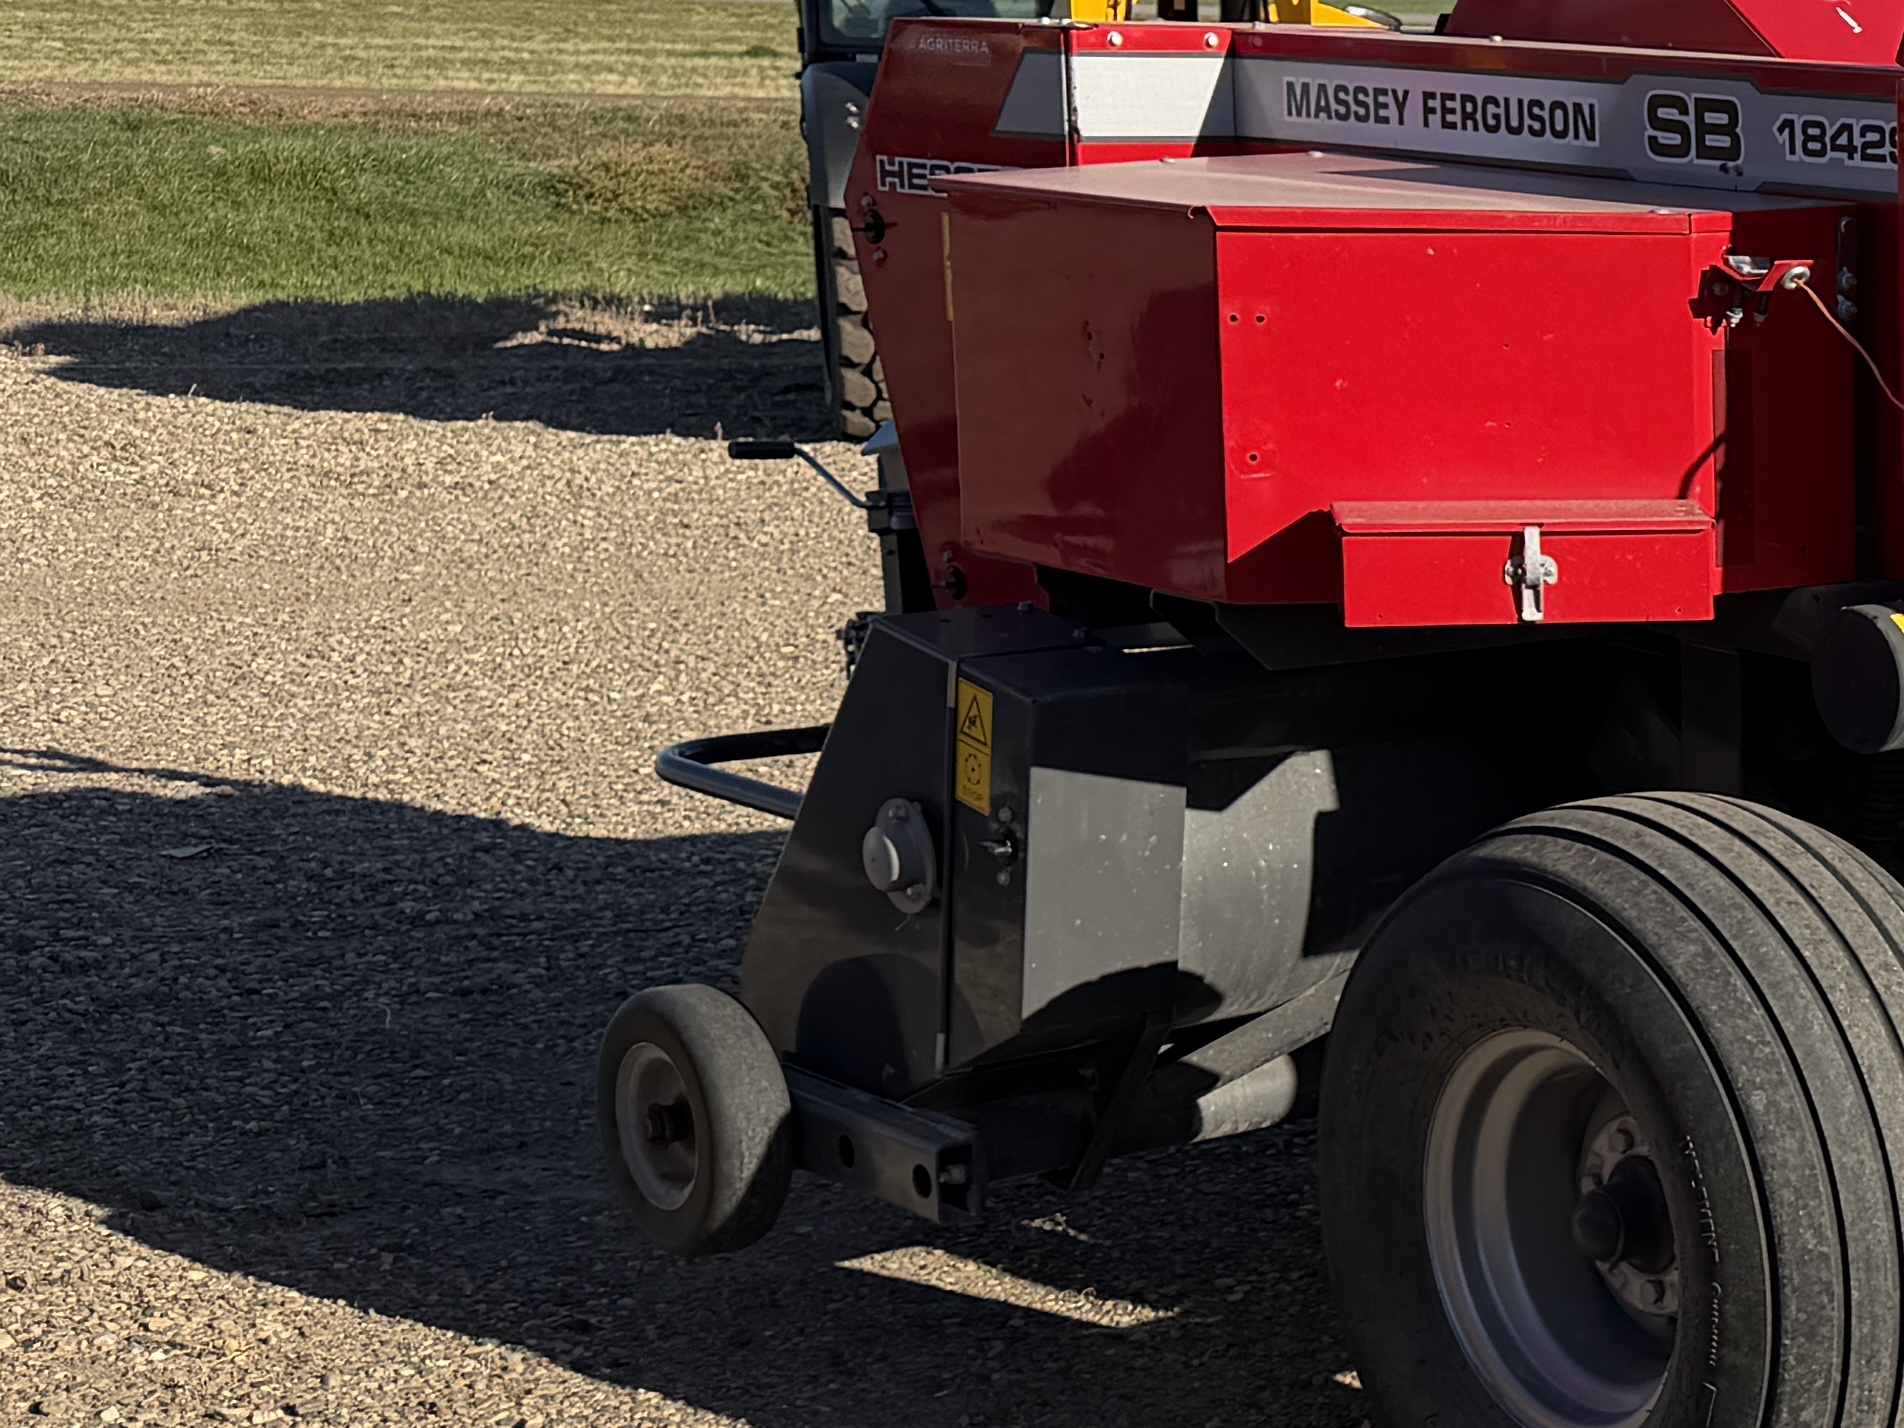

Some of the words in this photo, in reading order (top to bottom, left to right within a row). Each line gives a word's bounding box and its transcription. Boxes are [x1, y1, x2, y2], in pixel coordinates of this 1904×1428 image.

[917, 36, 990, 54] AGRITERRA
[1285, 79, 1411, 127] MASSEY
[1421, 89, 1598, 143] FERGUSON
[1645, 91, 1744, 164] SB
